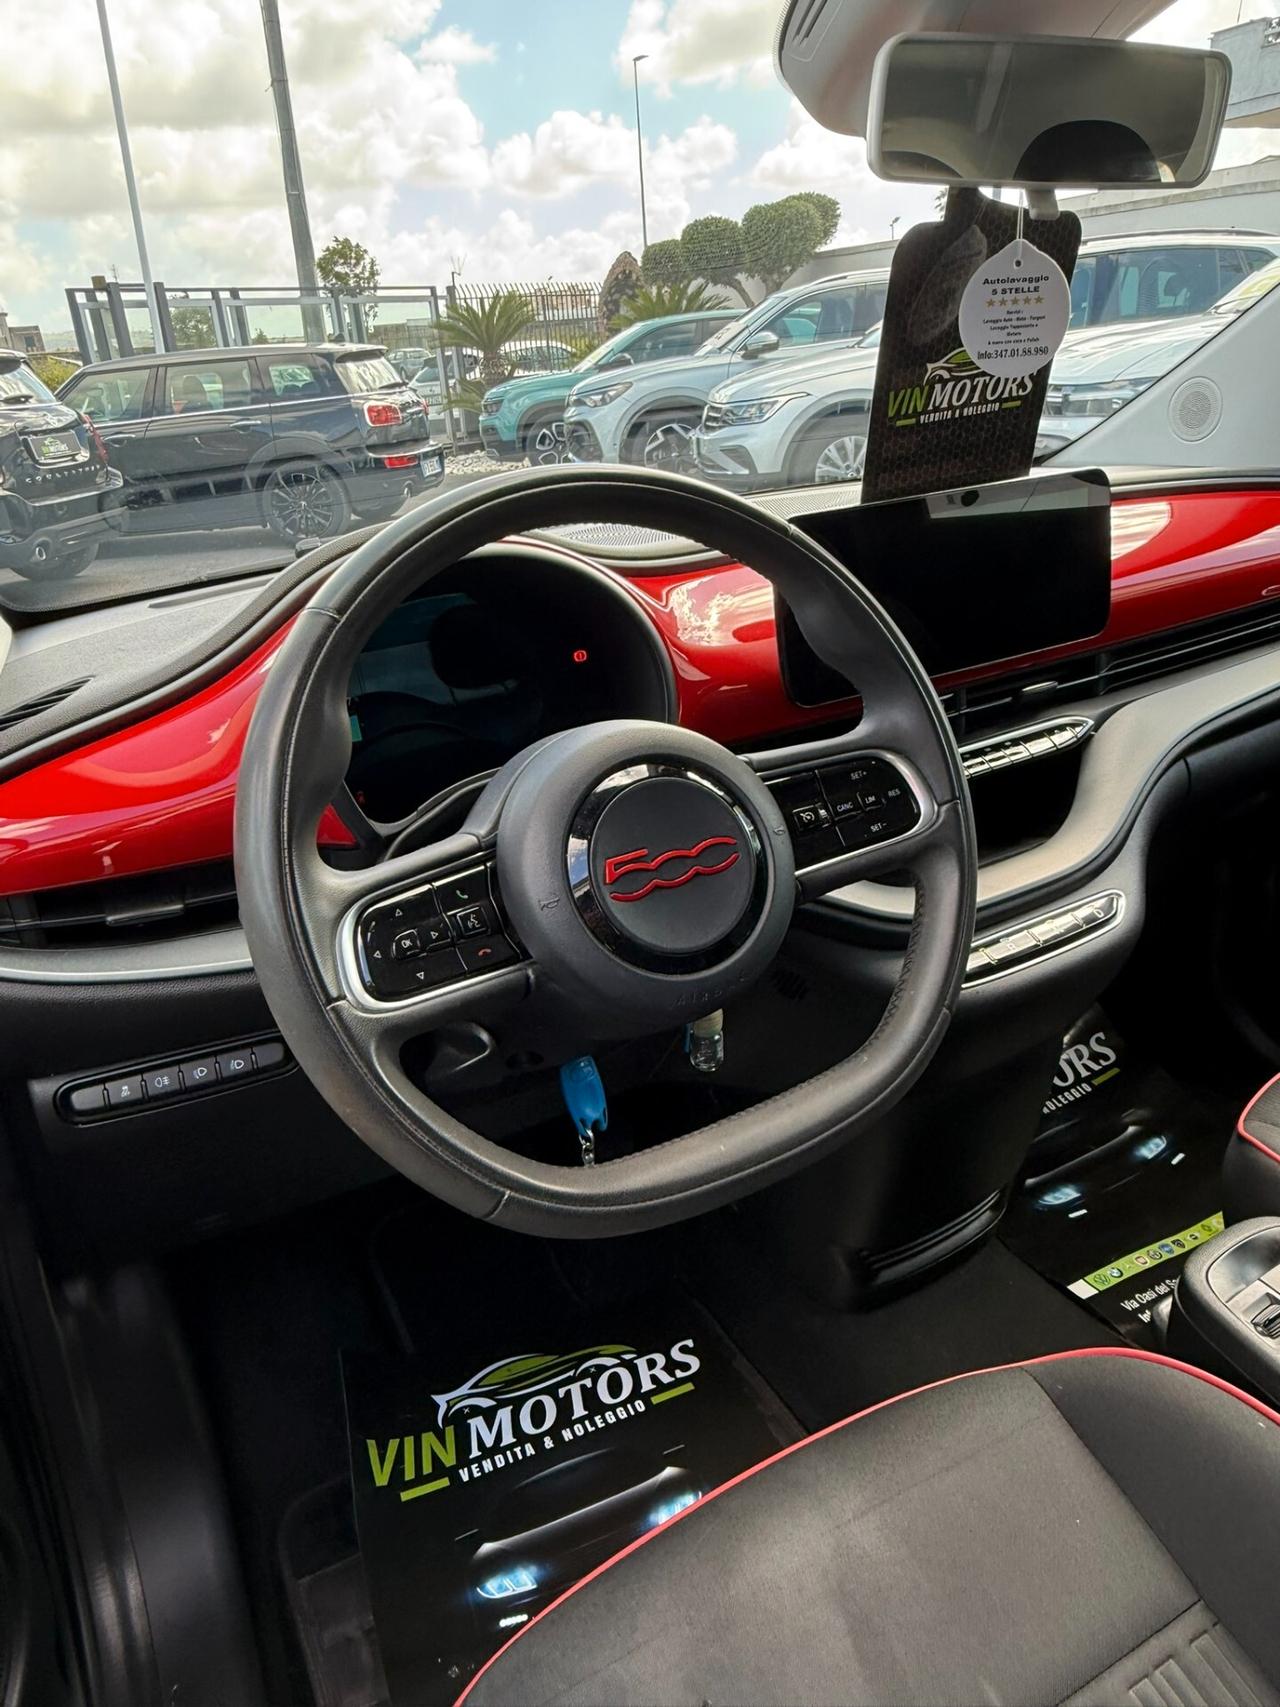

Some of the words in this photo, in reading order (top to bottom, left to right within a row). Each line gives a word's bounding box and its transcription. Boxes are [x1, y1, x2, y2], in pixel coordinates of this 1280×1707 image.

[982, 274, 1050, 285] Autolavaggio
[1001, 285, 1040, 295] STELLE
[888, 384, 929, 418] VIN
[927, 370, 1038, 411] MOTORS
[919, 411, 952, 425] VENDITA
[865, 795, 876, 804] LIM
[888, 788, 901, 798] RES
[836, 801, 854, 812] CANC
[604, 836, 741, 902] 500
[401, 937, 413, 949] OK
[1120, 1299, 1140, 1311] Via
[1135, 1288, 1158, 1304] Oasi
[1154, 1282, 1171, 1295] del
[366, 1425, 457, 1487] VIN
[467, 1338, 701, 1459] MOTORS
[458, 1444, 536, 1483] VENDITA
[543, 1435, 556, 1450] &
[561, 1399, 647, 1442] NOLEGGIO
